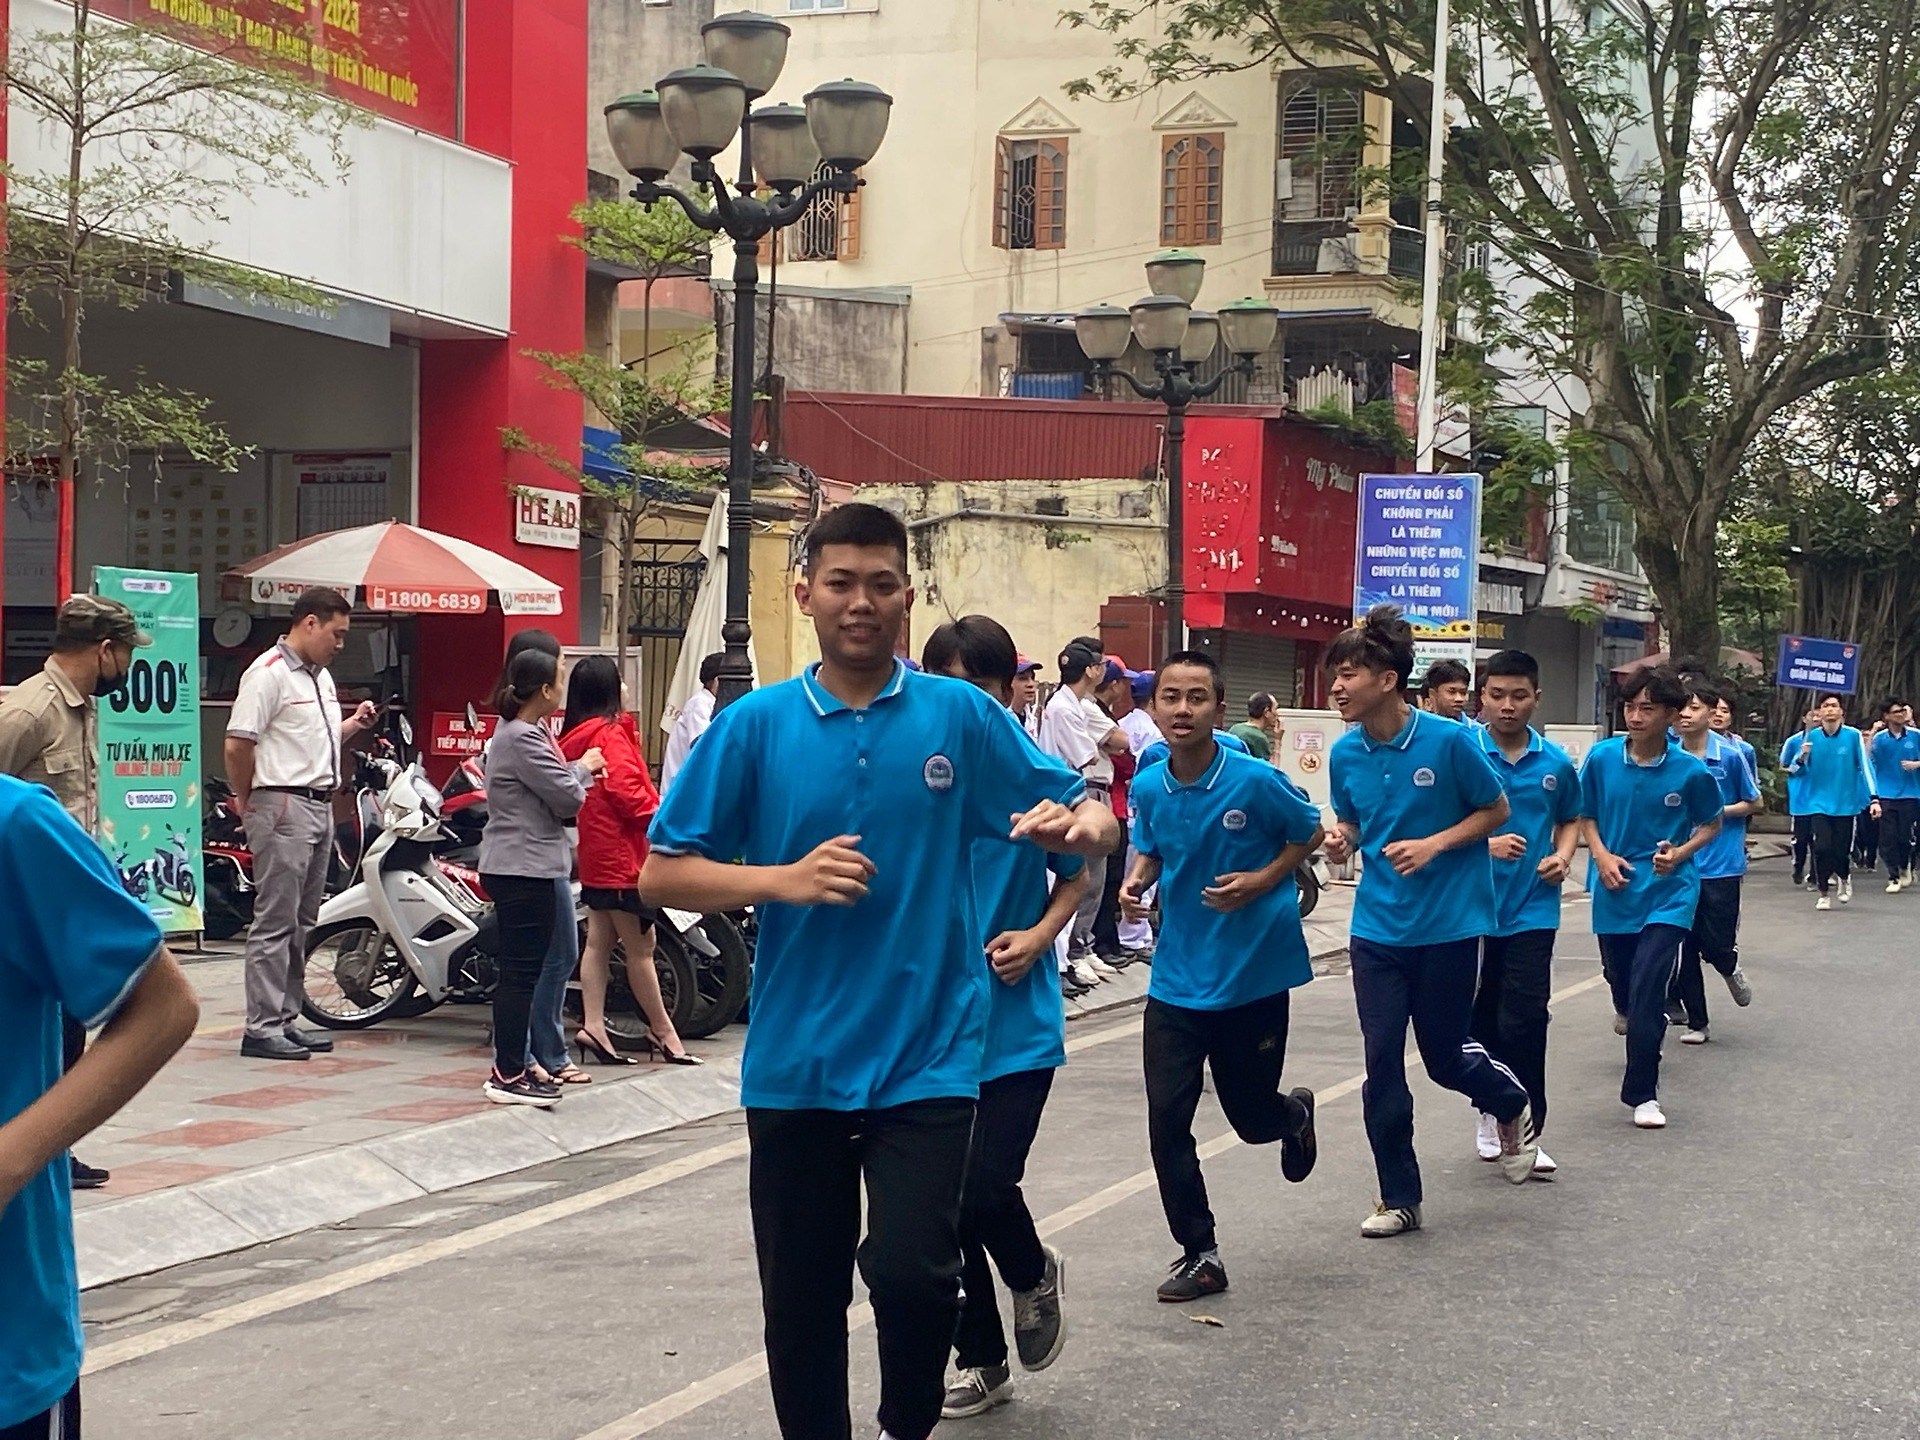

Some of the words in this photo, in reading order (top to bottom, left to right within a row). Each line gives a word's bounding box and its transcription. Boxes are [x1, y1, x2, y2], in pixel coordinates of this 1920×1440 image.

[390, 71, 419, 108] QUỐC
[522, 493, 577, 529] HEAD
[1383, 506, 1423, 519] KHÔNG
[1425, 505, 1454, 519] PHẢI
[1391, 525, 1406, 538] LÀ
[1409, 526, 1442, 538] THÊM
[1409, 546, 1436, 560] VIỆC
[1391, 583, 1406, 597] LÀ
[1408, 584, 1442, 597] THÊM
[389, 591, 481, 610] 1800-6839
[179, 662, 188, 684] K
[437, 734, 456, 749] TIẾP
[152, 743, 174, 761] MUA
[177, 743, 192, 761] XE
